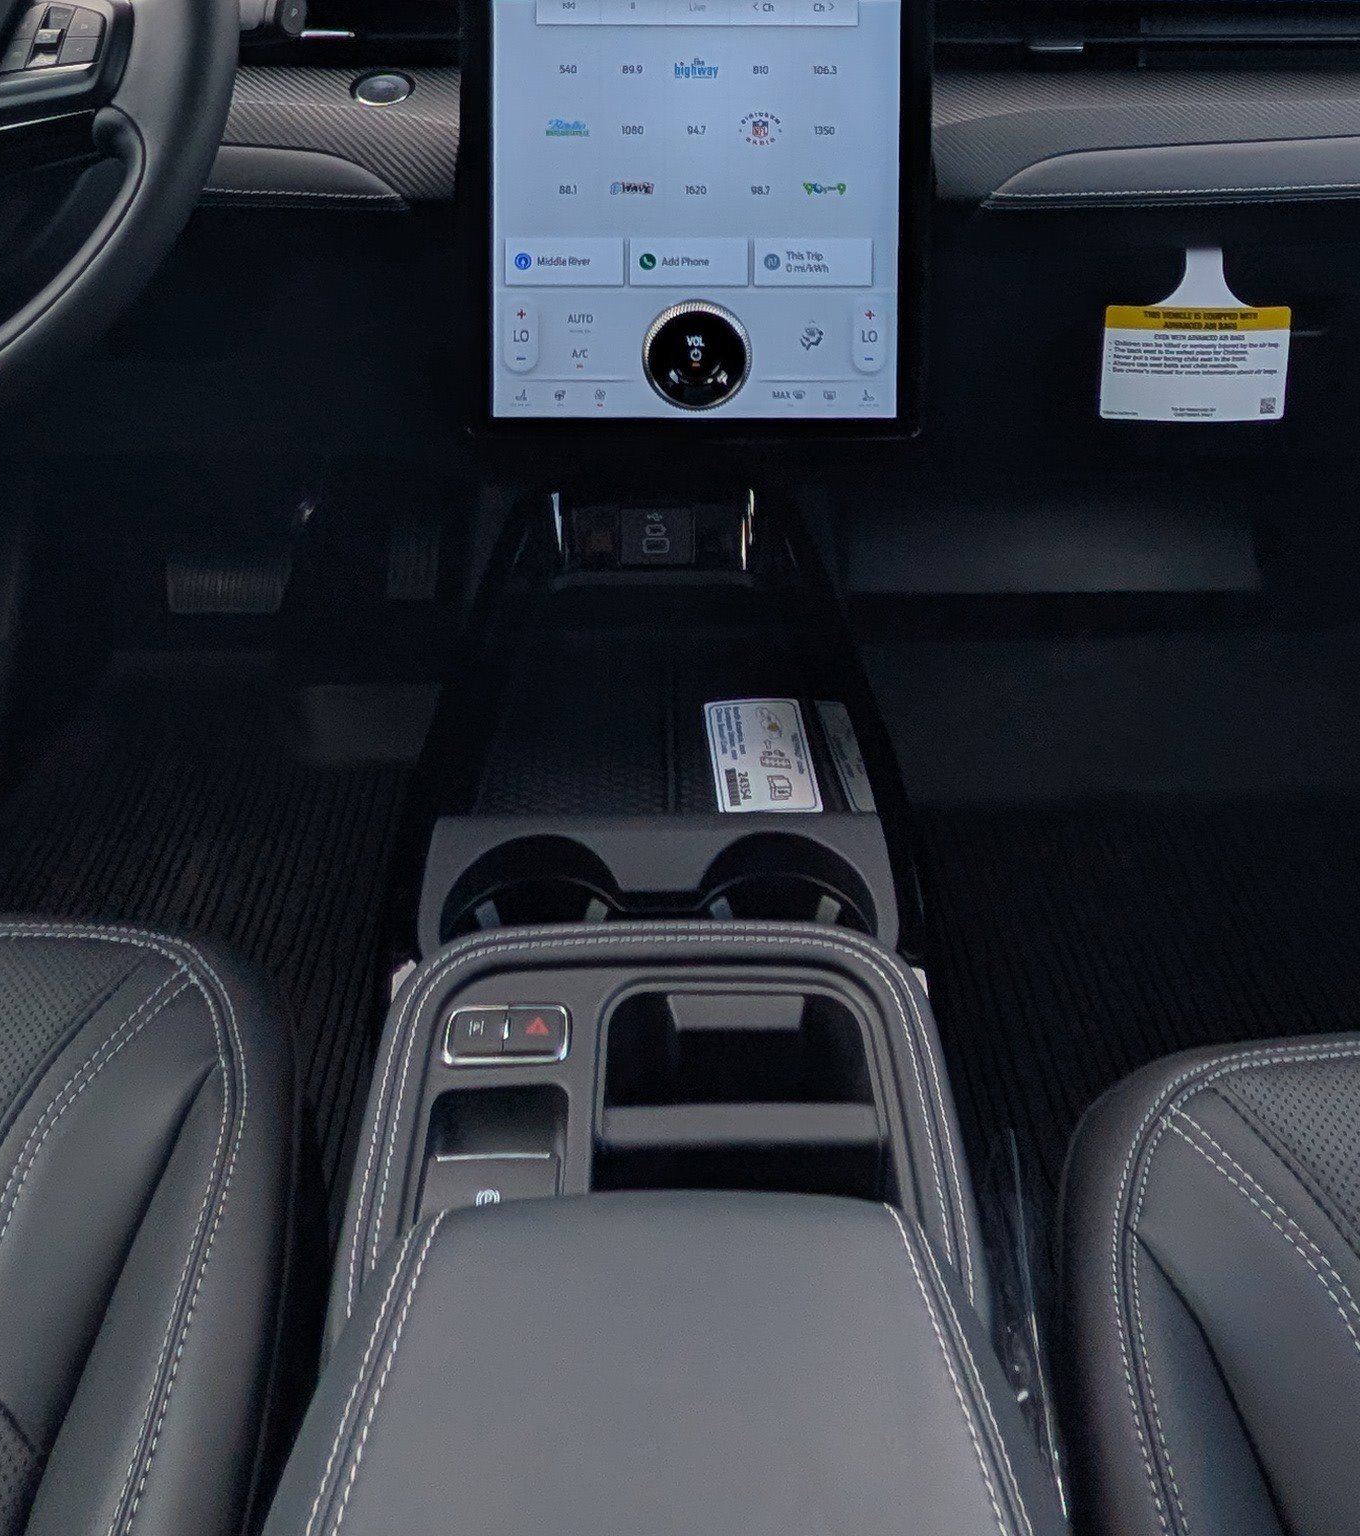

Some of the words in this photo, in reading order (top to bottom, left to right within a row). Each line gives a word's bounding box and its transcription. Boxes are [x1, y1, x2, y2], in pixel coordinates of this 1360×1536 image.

[559, 65, 577, 74] 540
[622, 65, 643, 74] 89.9
[674, 61, 718, 79] highway
[752, 66, 769, 75] 810
[813, 66, 837, 75] 106.3
[537, 257, 567, 266] Middle
[568, 257, 590, 266] River
[786, 251, 804, 261] This
[805, 251, 824, 262] Trip
[661, 257, 679, 267] Add
[681, 257, 710, 267] Phone
[567, 314, 593, 324] AUTO
[513, 330, 529, 343] LO
[686, 335, 705, 347] VOL
[862, 330, 878, 343] LO
[572, 349, 588, 359] A/C
[772, 391, 791, 400] MAX
